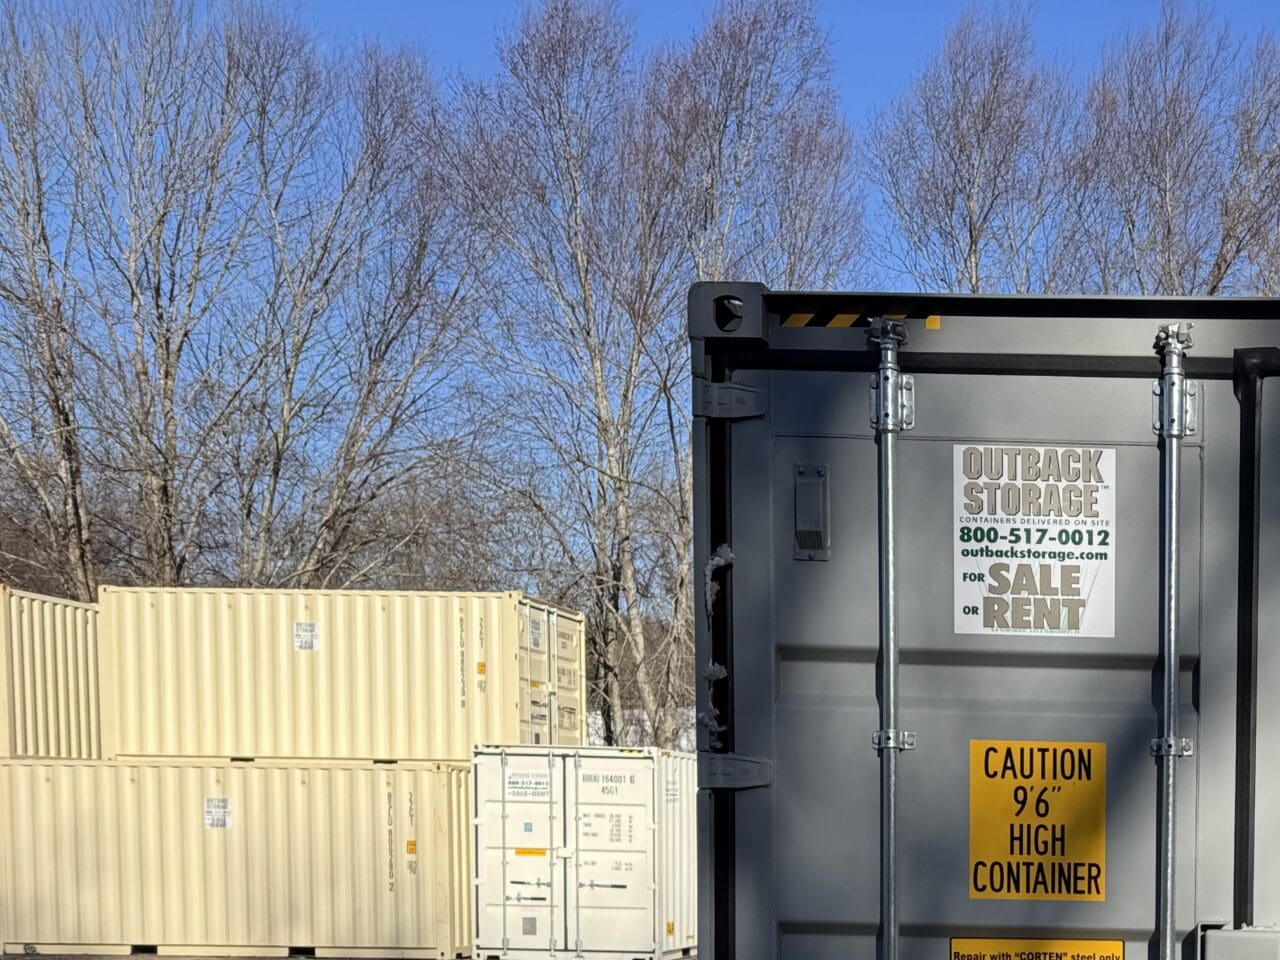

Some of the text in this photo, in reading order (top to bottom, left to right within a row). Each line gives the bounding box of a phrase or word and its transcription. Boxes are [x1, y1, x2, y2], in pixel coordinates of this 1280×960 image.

[962, 446, 1105, 483] OUTBACK
[963, 481, 1100, 518] STORAGE
[959, 516, 1017, 525] CONTAINERS
[1020, 517, 1071, 526] DELIVERED
[1091, 519, 1110, 527] SITE
[959, 526, 1110, 546] 800-517-0012
[960, 546, 1108, 562] outbackstorage.com
[962, 562, 1081, 597] FOR SALE
[962, 596, 1086, 630] OR RENT
[984, 746, 1092, 781] CAUTION
[1009, 823, 1066, 856] HIGH
[973, 860, 1101, 895] CONTAINER
